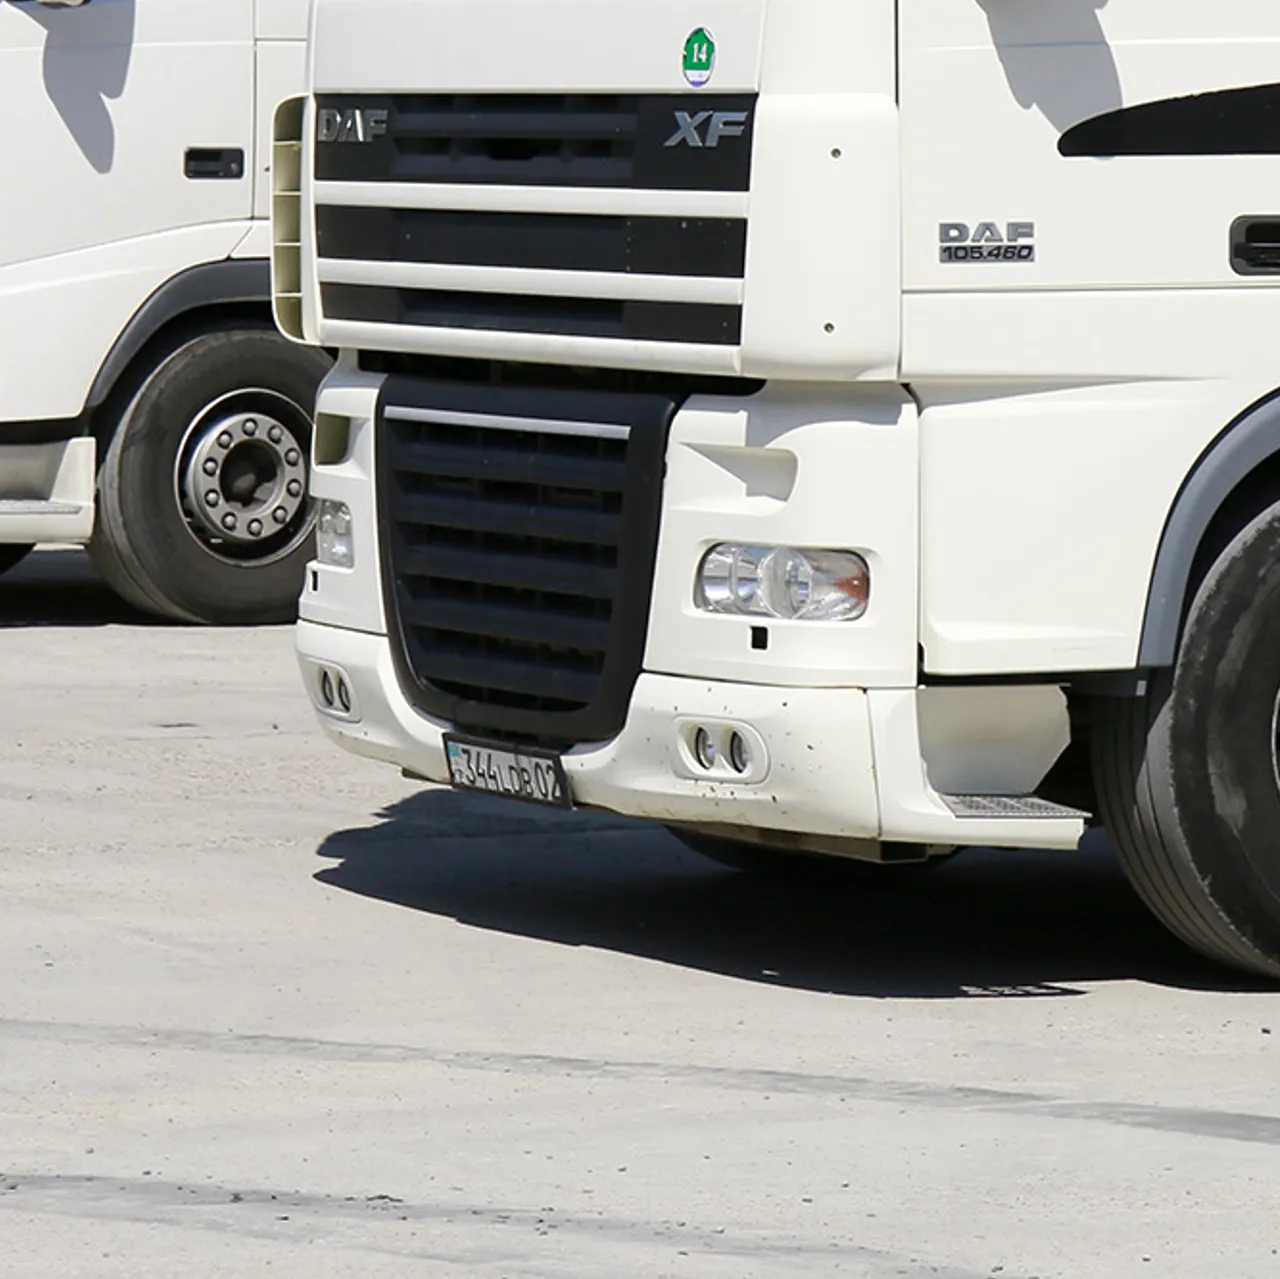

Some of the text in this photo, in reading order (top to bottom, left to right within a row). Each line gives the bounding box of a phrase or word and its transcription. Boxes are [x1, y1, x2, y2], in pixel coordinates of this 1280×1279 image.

[692, 42, 708, 63] 14
[317, 108, 389, 143] DAF
[662, 110, 749, 148] XF
[938, 221, 1035, 244] DAF
